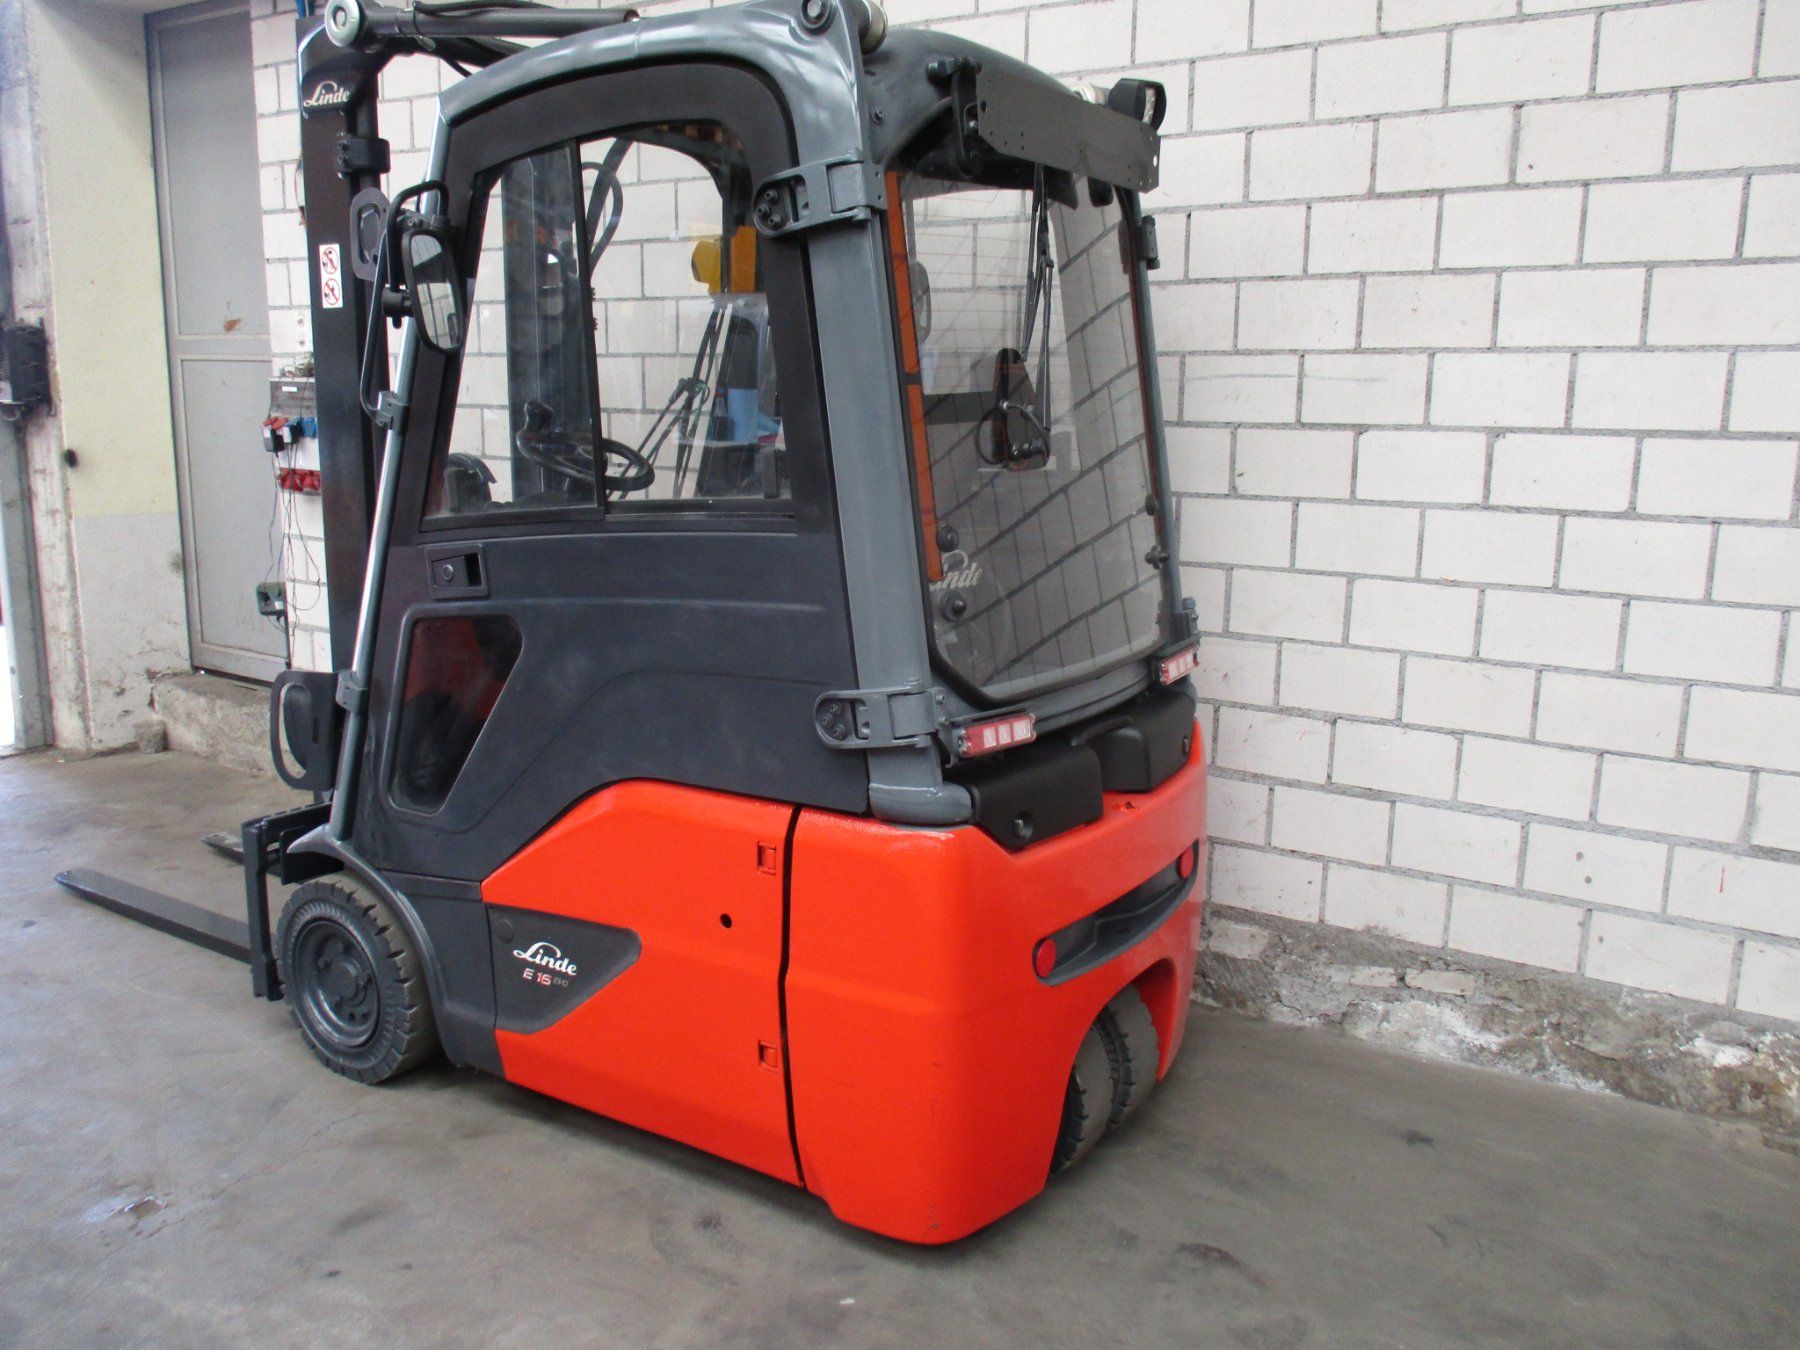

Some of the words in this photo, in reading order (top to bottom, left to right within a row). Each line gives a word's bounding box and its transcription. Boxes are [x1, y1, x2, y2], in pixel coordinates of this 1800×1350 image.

[303, 81, 350, 107] Linde
[513, 942, 577, 976] Linde
[523, 968, 535, 980] E
[537, 972, 552, 986] 16
